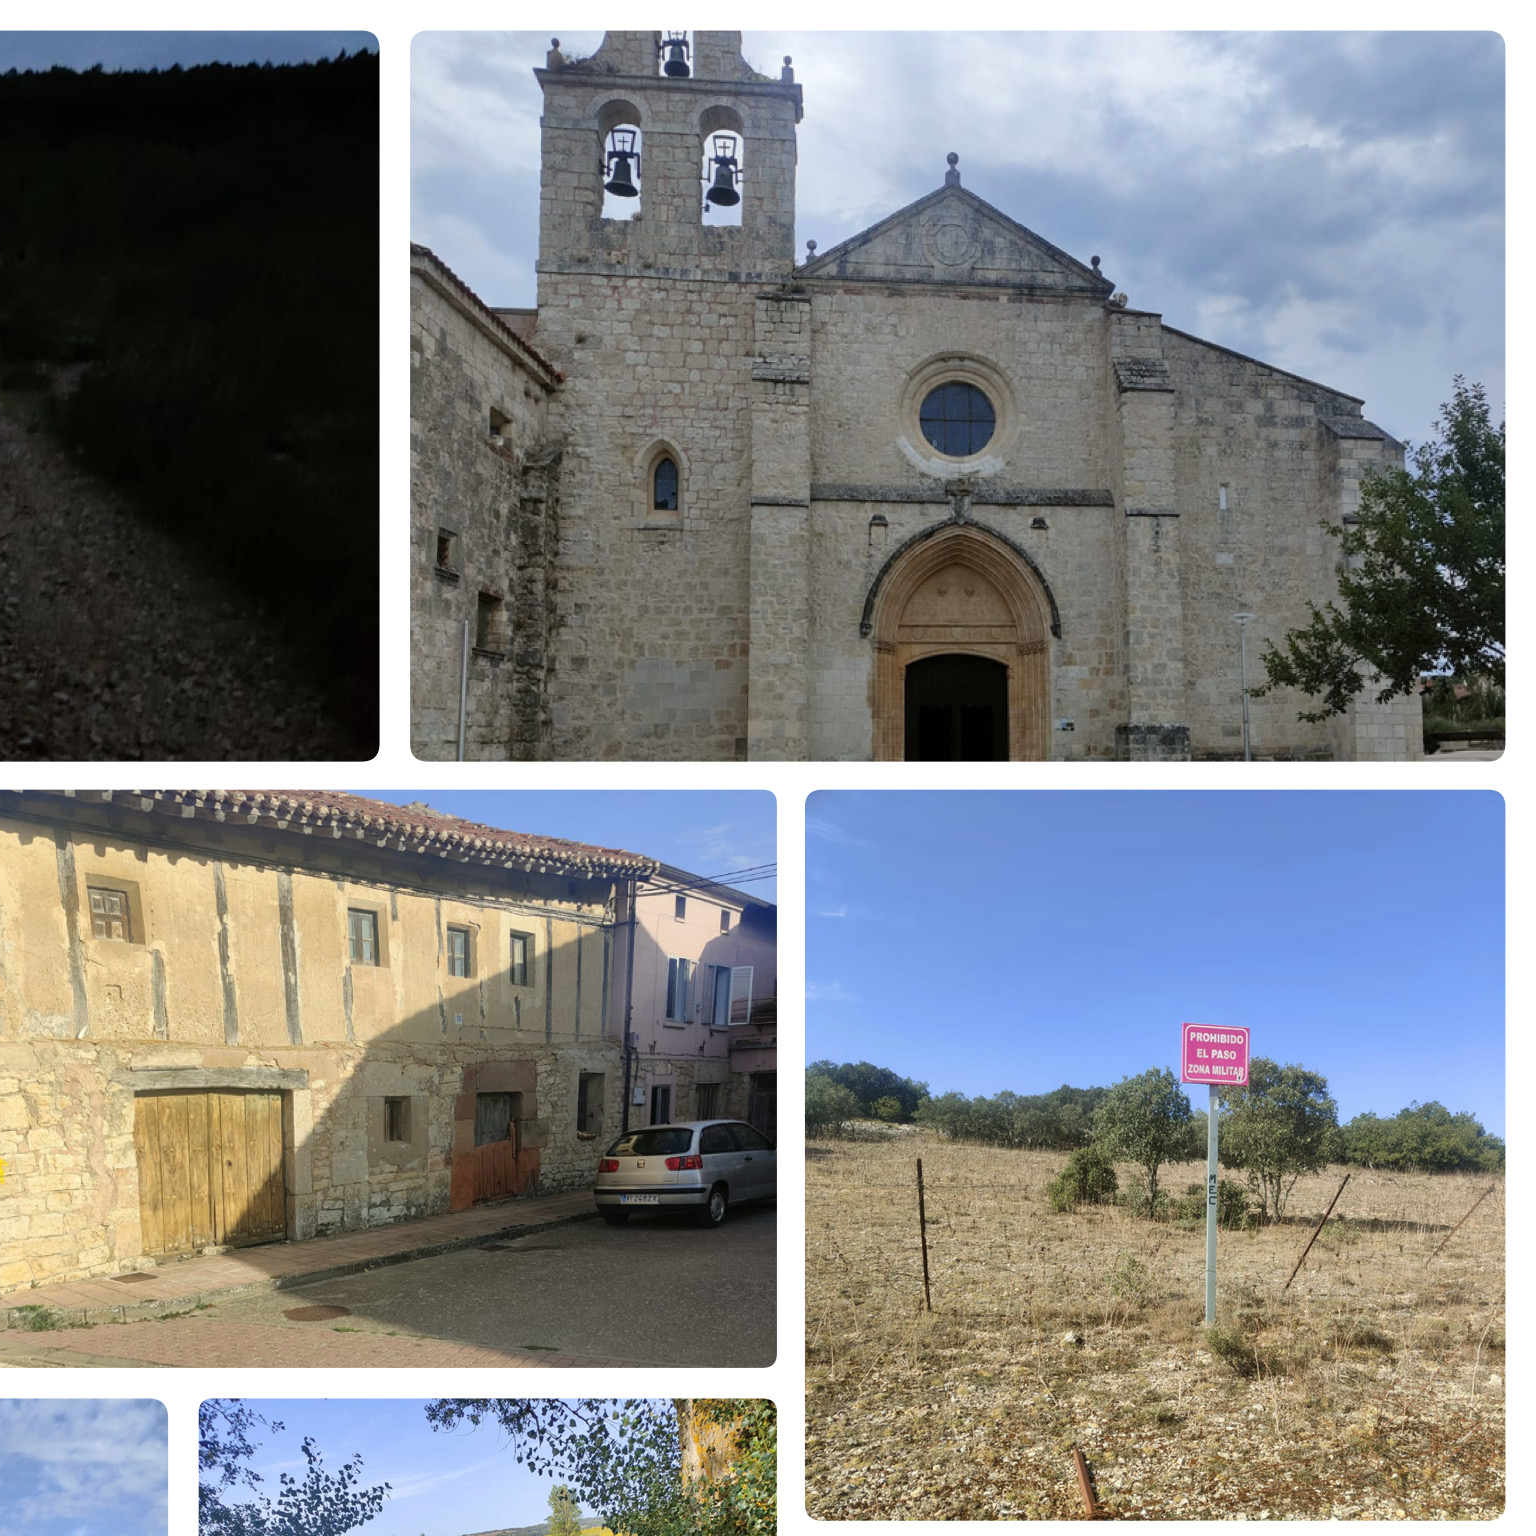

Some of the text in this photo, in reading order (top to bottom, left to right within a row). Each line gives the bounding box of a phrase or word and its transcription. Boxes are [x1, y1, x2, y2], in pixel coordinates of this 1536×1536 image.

[1190, 1032, 1244, 1044] PROHIBIDO
[1197, 1048, 1237, 1060] EL PASO
[1188, 1064, 1244, 1077] ZONA MILITAR
